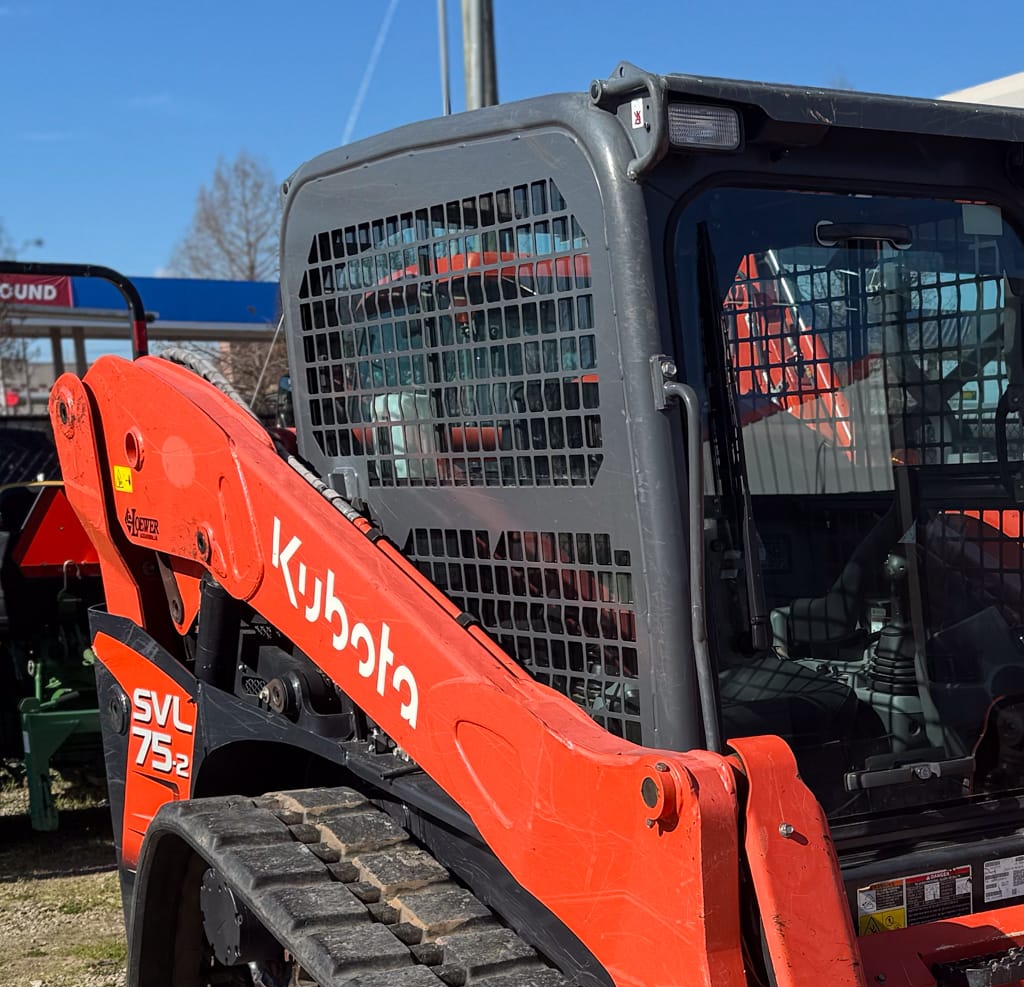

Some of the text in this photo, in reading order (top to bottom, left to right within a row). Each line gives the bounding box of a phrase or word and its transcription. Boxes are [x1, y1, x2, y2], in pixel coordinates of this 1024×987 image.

[131, 508, 159, 537] LOEWER
[261, 515, 419, 730] Kubota
[133, 687, 193, 734] SVL
